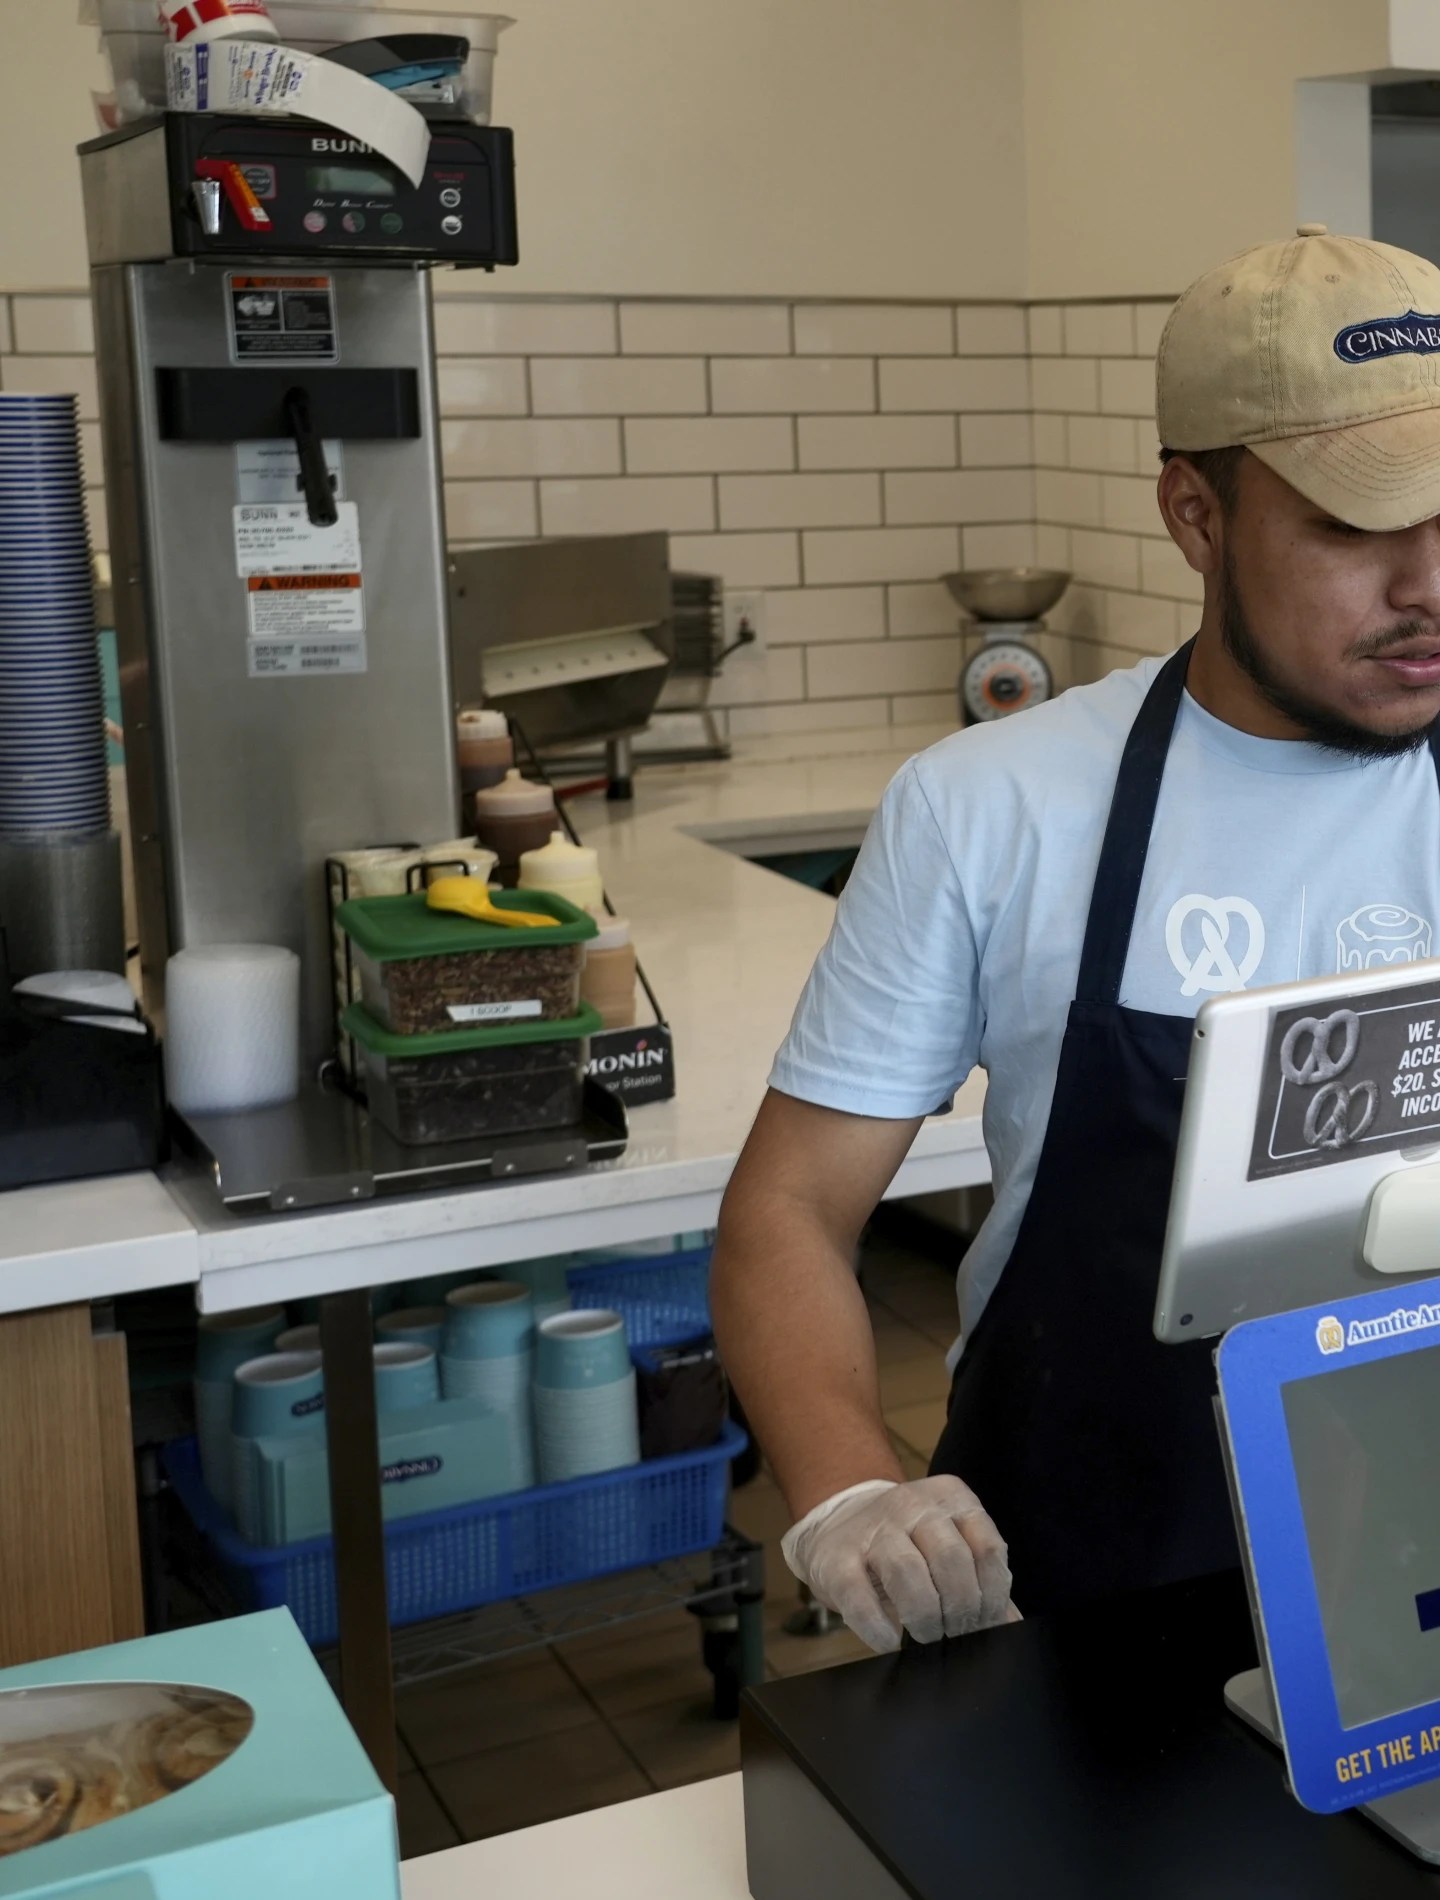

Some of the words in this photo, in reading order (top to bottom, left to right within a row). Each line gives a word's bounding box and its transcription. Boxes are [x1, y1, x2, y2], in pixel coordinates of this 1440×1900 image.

[1408, 1020, 1435, 1043] WE
[622, 1073, 663, 1091] Station
[1391, 1072, 1427, 1099] $20.
[1335, 1748, 1373, 1784] GET
[1376, 1735, 1416, 1769] THE
